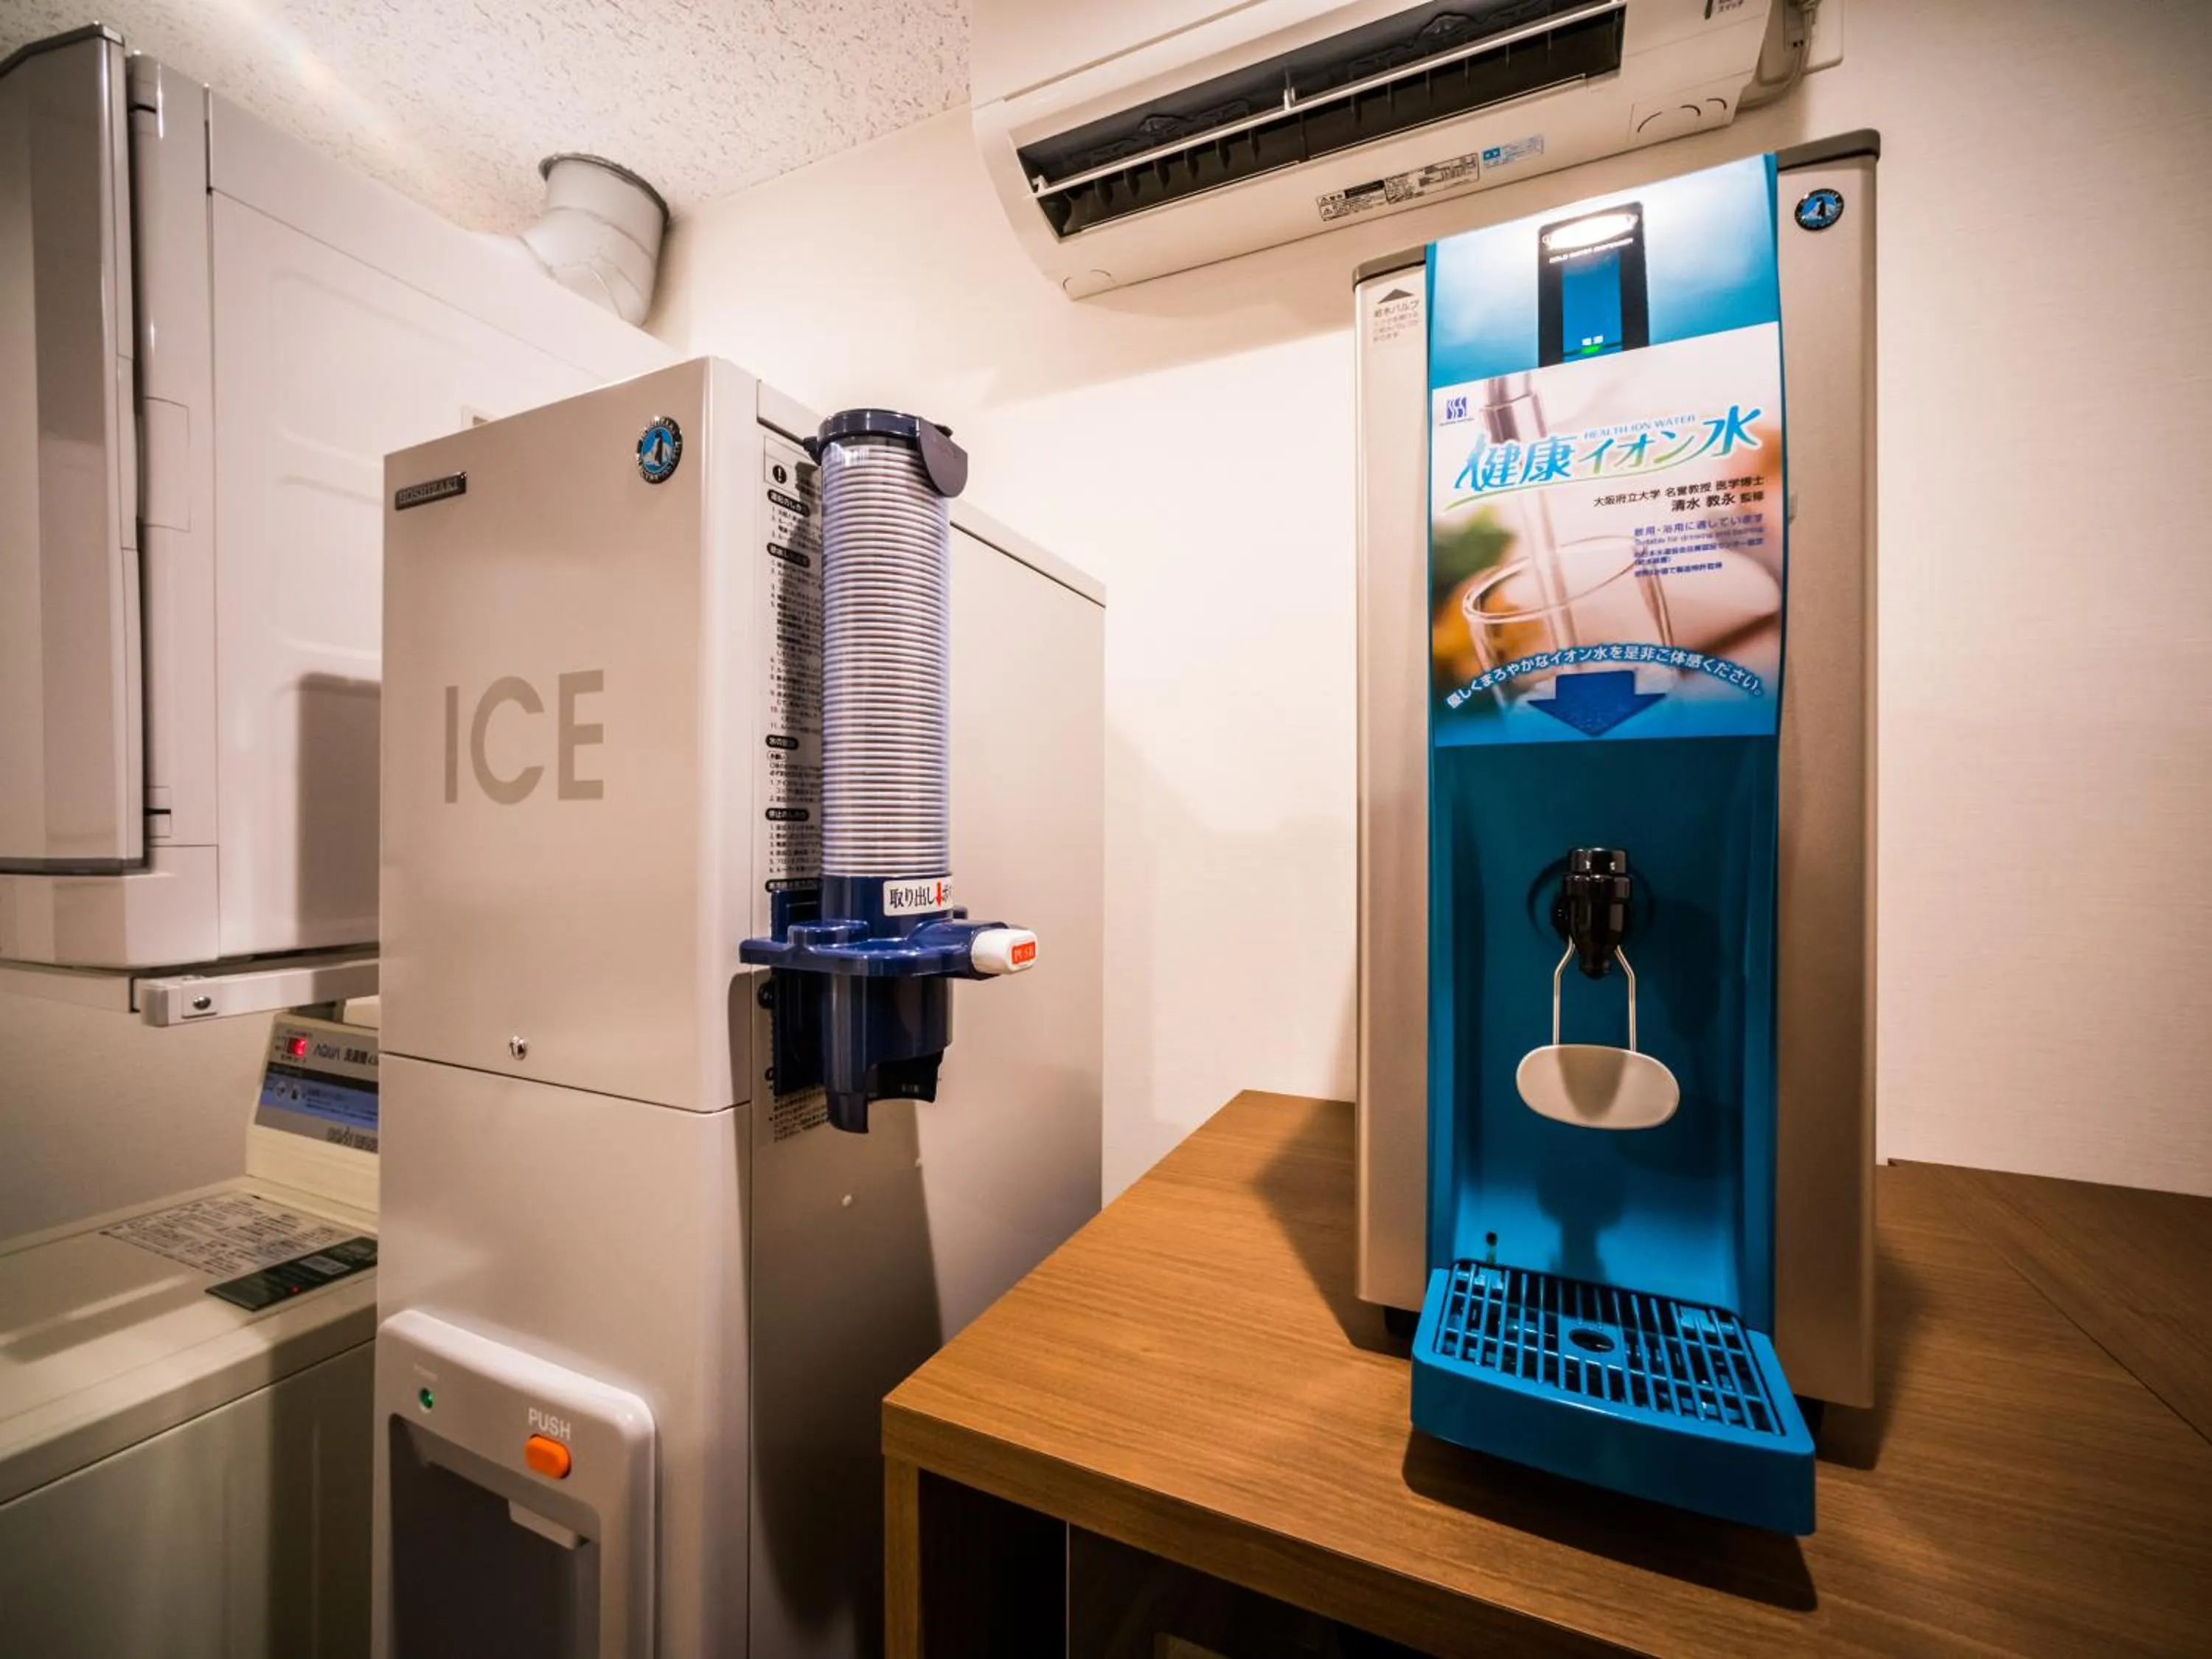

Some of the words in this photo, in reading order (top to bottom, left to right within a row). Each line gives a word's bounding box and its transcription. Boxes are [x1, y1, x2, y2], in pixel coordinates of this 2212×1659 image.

[1654, 414, 1696, 428] WATER
[1454, 405, 1761, 492] 健康イオン水
[1672, 498, 1700, 512] 清水
[445, 669, 604, 804] ICE
[528, 1407, 571, 1440] PUSH
